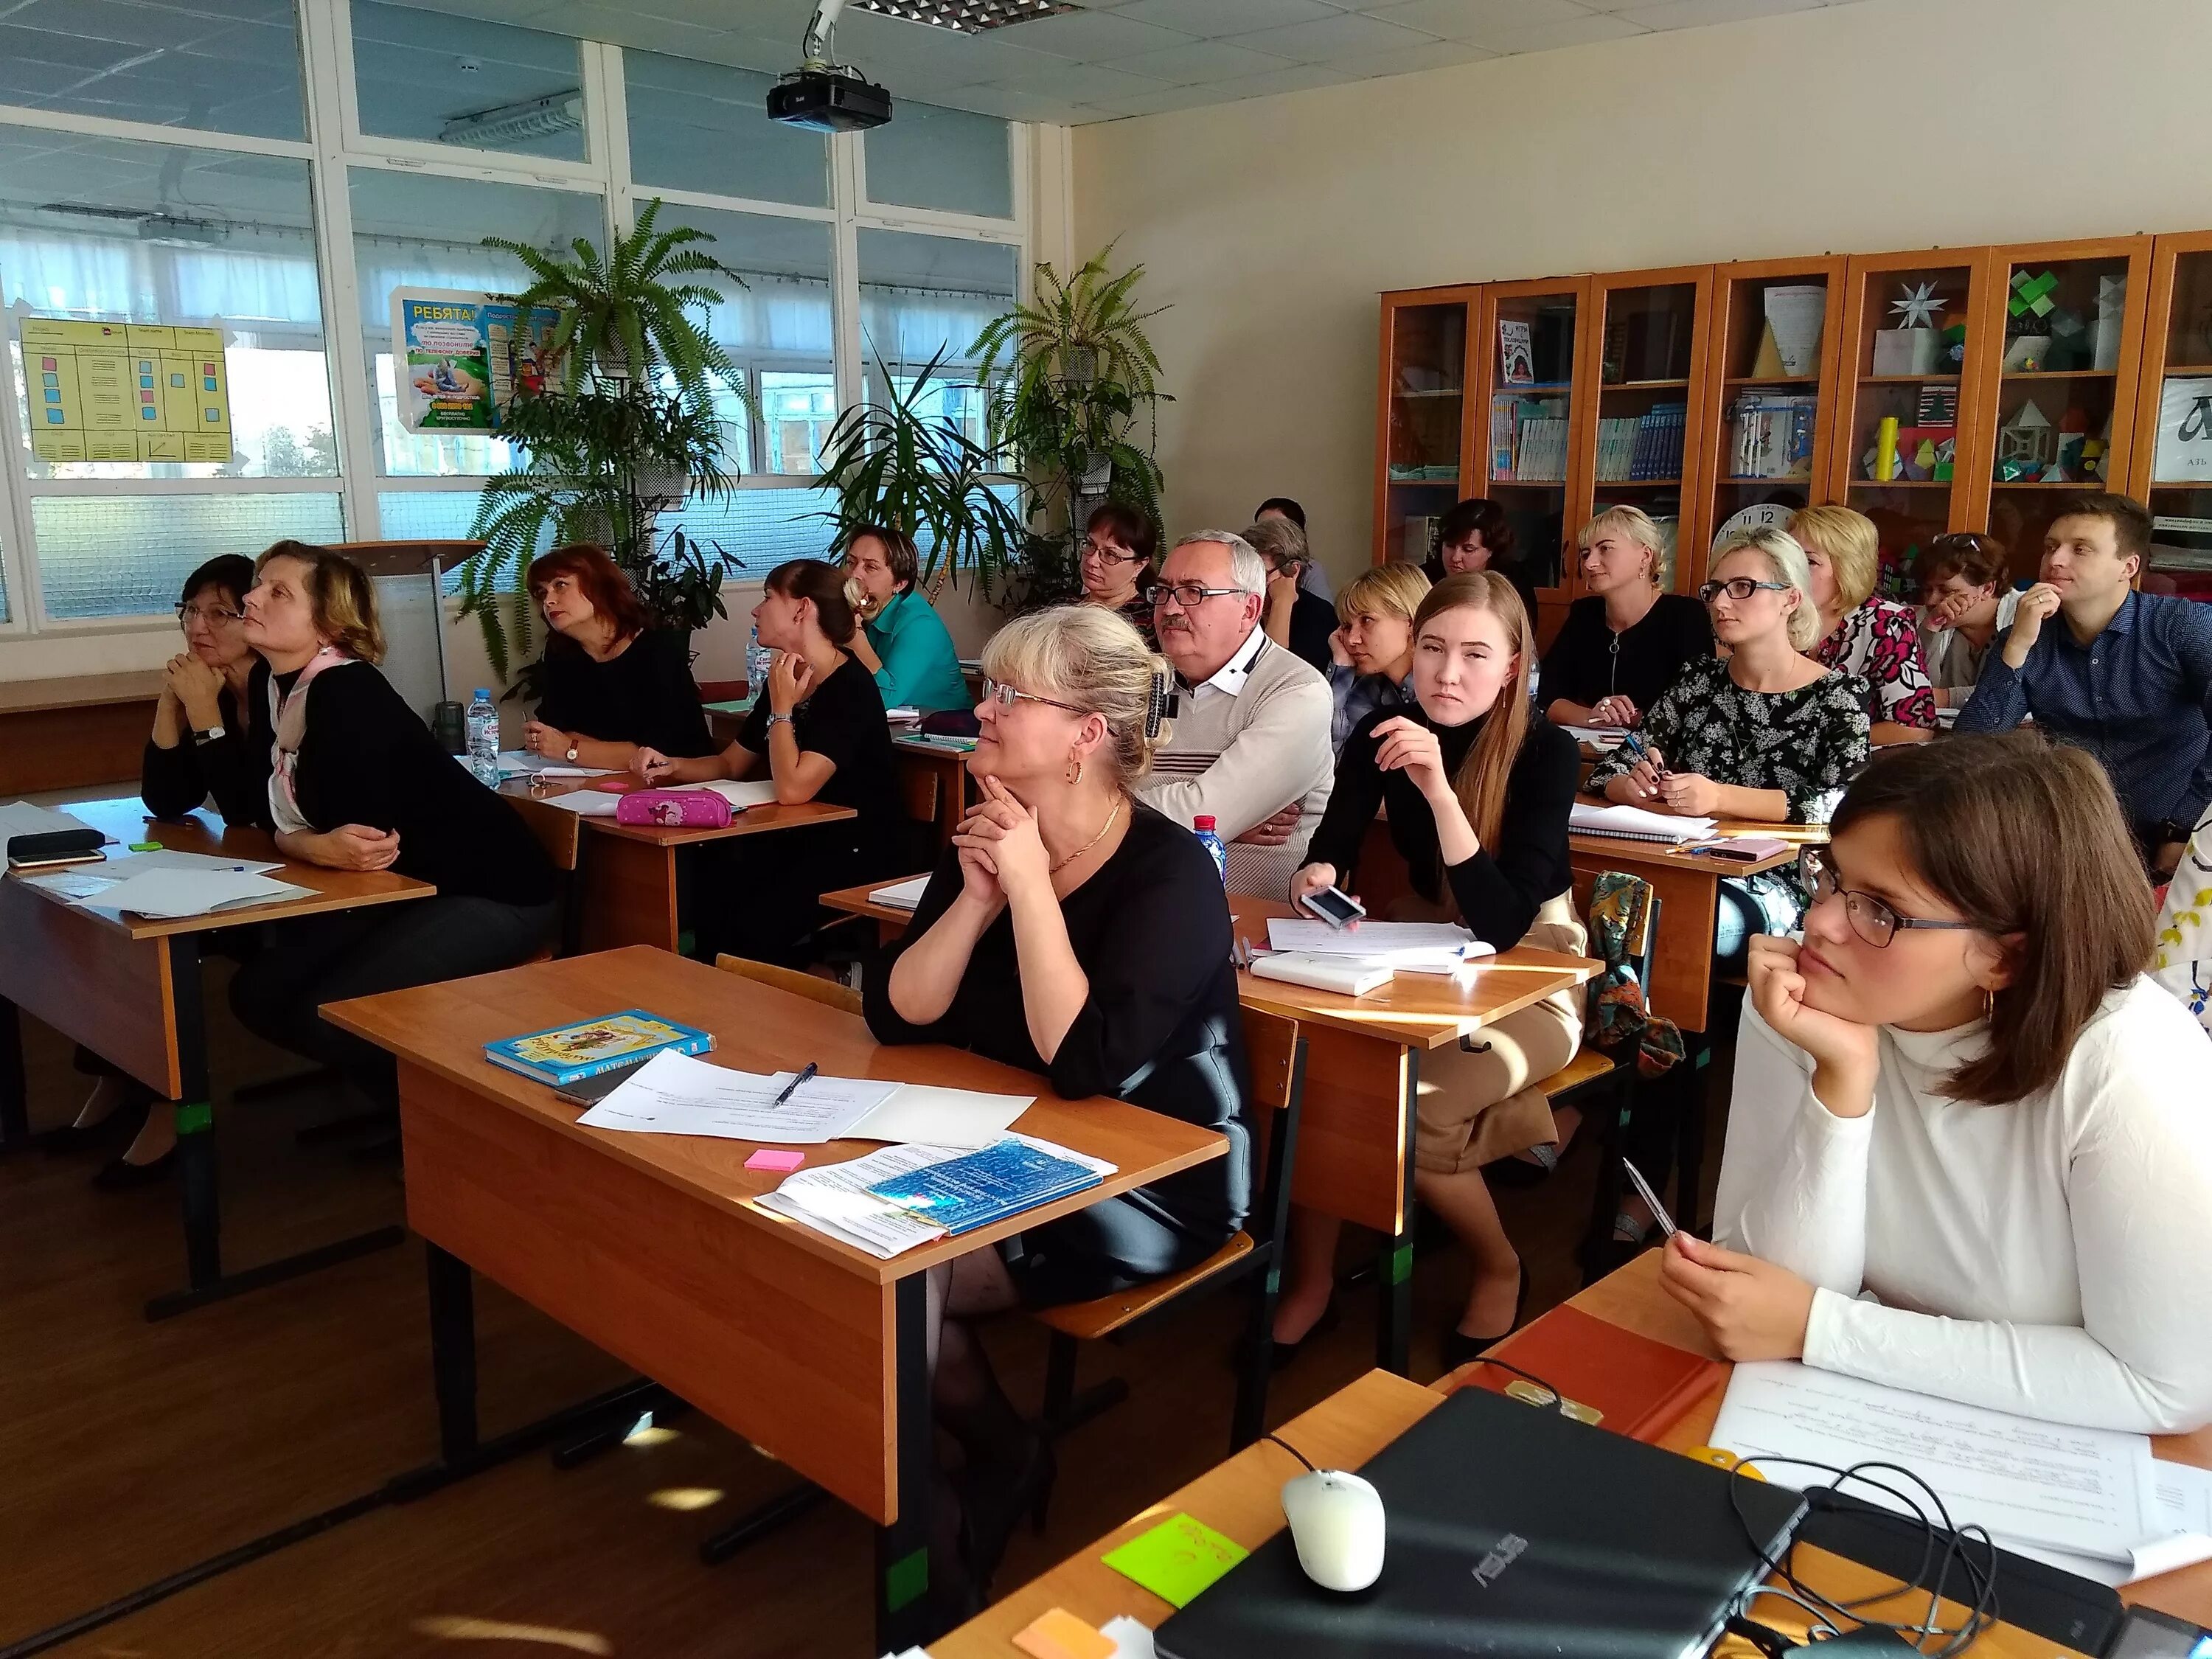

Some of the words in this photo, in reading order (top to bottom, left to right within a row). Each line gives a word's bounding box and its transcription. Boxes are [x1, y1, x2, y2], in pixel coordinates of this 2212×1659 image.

[414, 305, 476, 321] РЕБЯТА!
[1743, 515, 1752, 525] 11
[1761, 511, 1774, 524] 12
